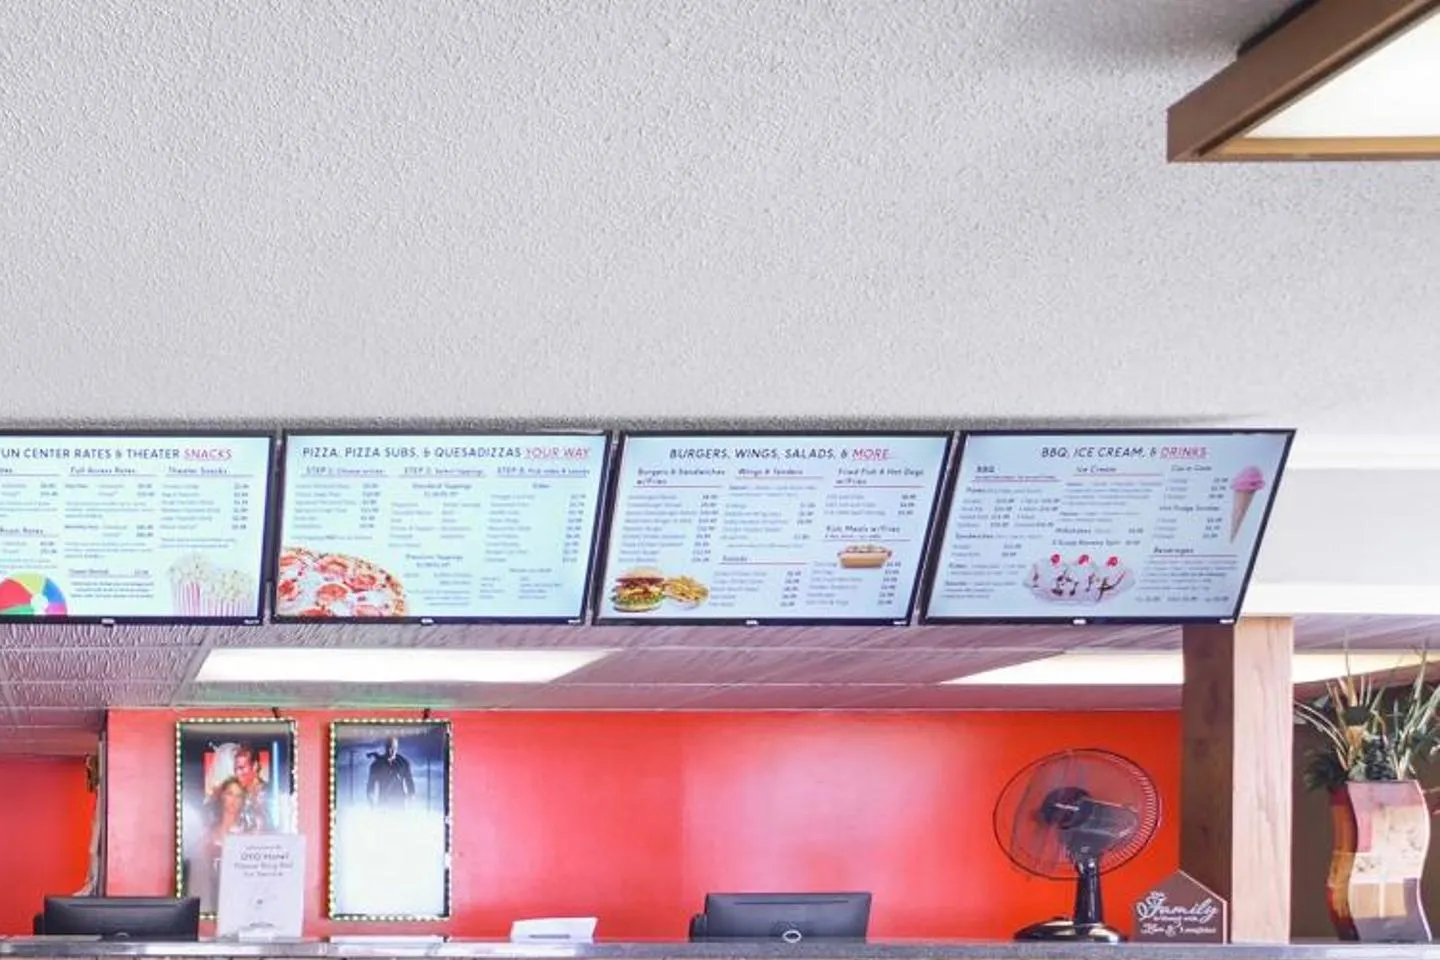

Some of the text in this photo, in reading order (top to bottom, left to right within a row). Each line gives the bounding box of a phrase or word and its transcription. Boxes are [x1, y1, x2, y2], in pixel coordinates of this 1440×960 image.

[23, 448, 70, 459] CENTER
[74, 448, 112, 459] RATES
[126, 448, 180, 460] THEATER
[183, 448, 233, 461] SNACKS
[344, 447, 381, 458] PIZZA
[434, 447, 522, 458] QUESADIZZAS
[525, 447, 559, 459] YOUR
[563, 447, 591, 459] WAY
[1073, 447, 1095, 458] ICE
[1160, 447, 1207, 459] DRINKS
[1136, 897, 1218, 924] Family
